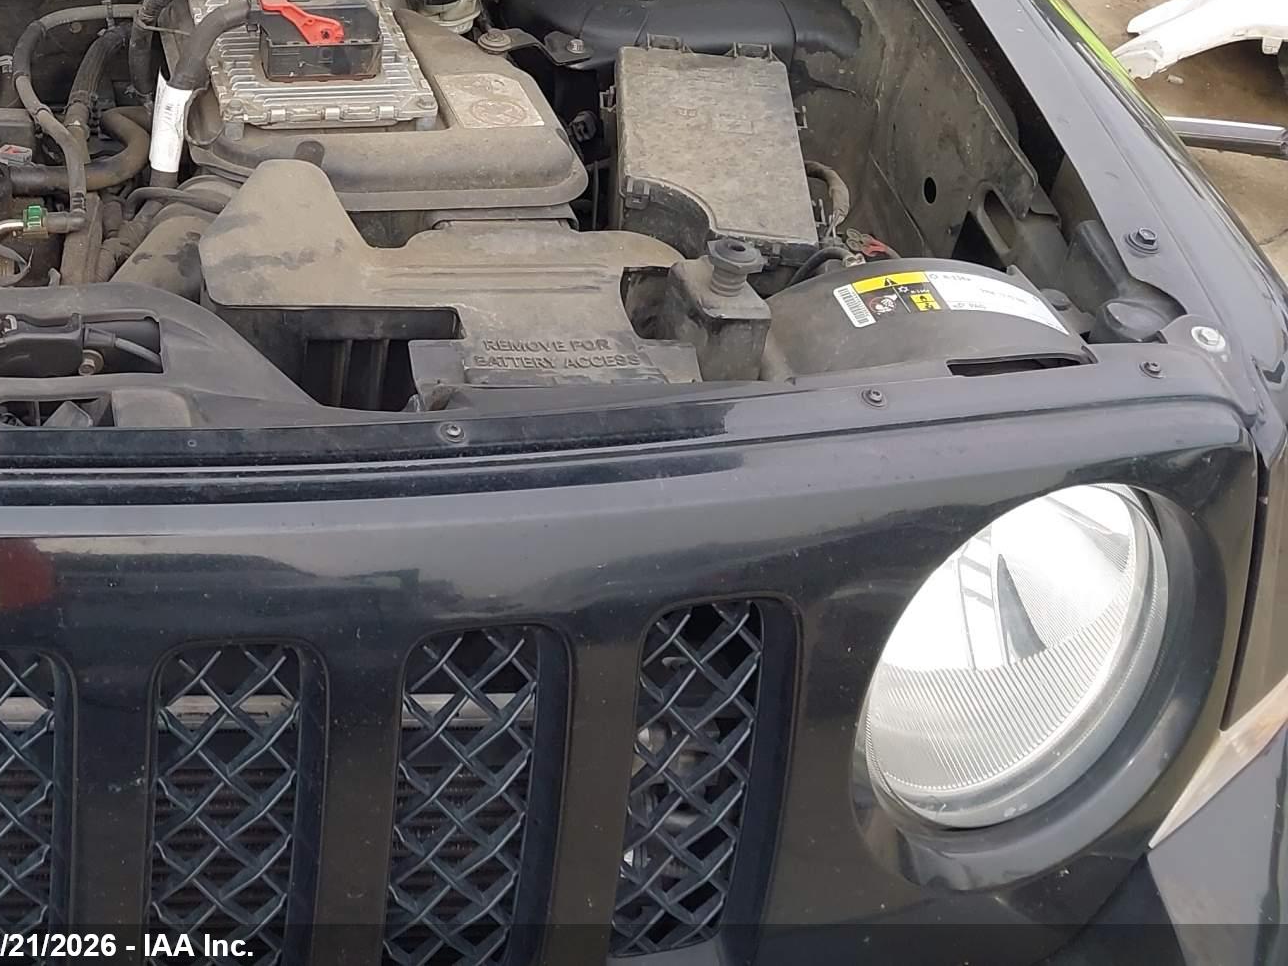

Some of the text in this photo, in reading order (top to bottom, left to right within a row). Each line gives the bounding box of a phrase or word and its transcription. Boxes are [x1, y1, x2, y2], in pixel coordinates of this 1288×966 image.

[483, 338, 611, 352] REMOVE FOR
[474, 354, 641, 369] BATTERY ACCESS
